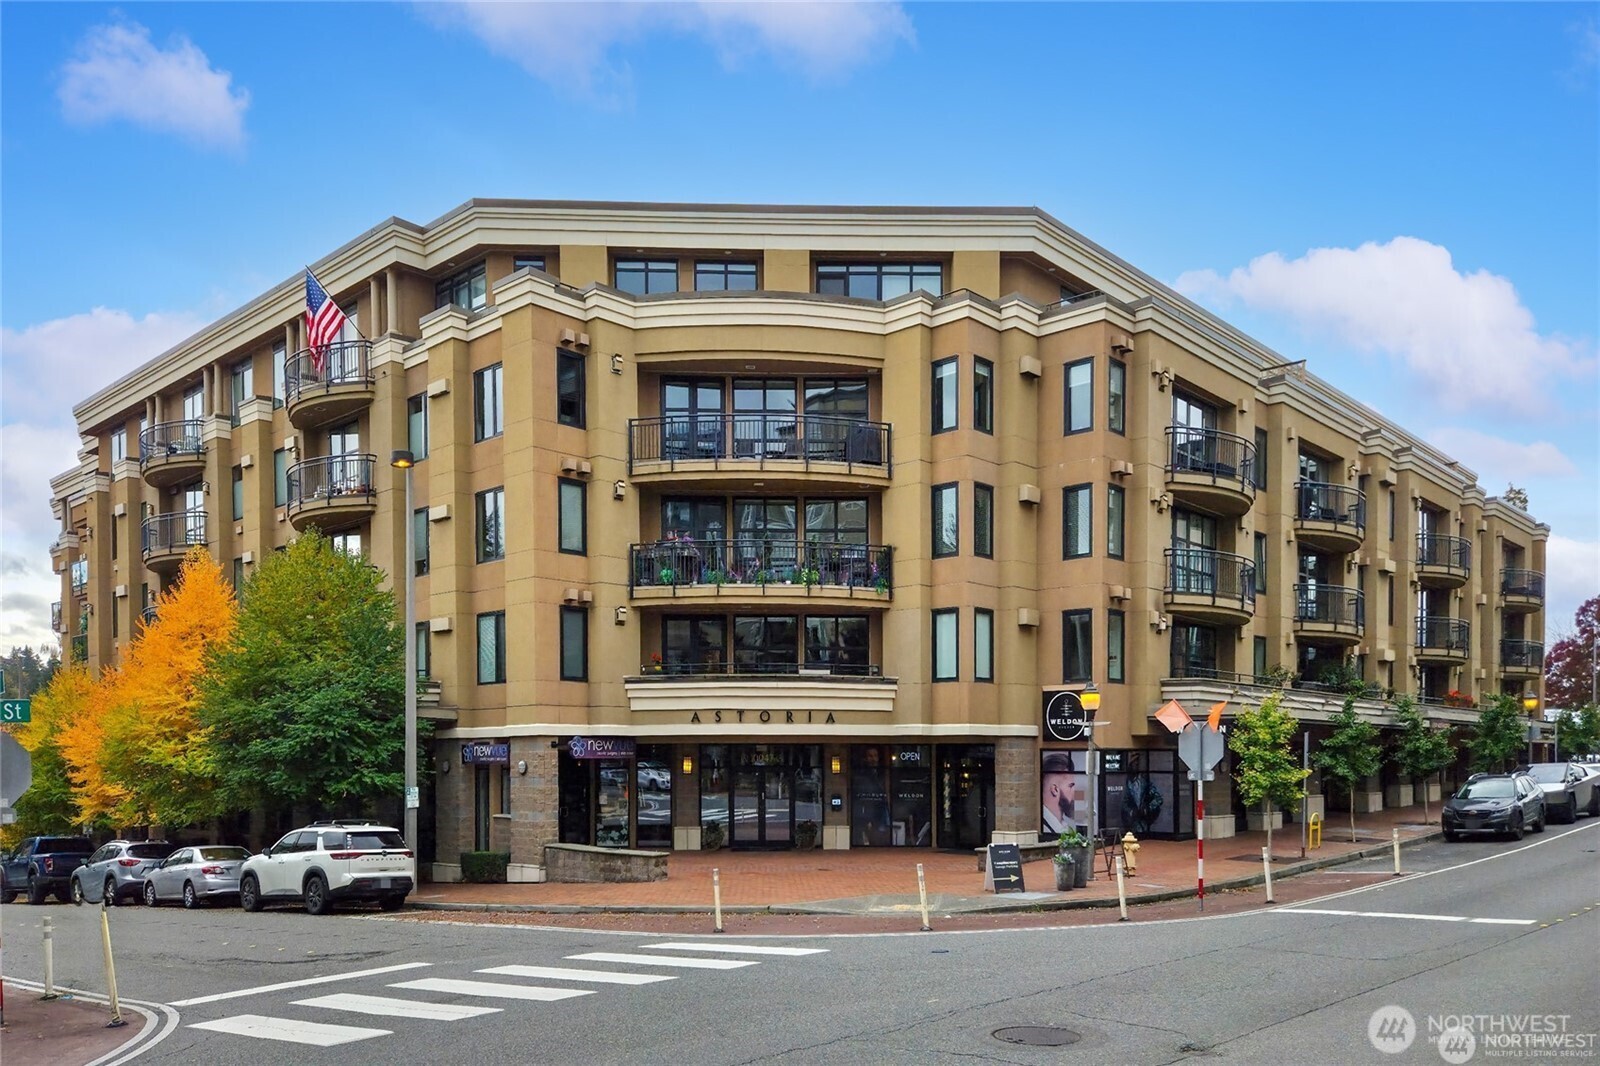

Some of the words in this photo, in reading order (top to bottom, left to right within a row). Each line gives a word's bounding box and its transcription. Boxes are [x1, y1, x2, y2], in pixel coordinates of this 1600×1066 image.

[3, 702, 22, 720] St
[690, 709, 836, 724] ASTORIA
[900, 751, 920, 761] OPEN
